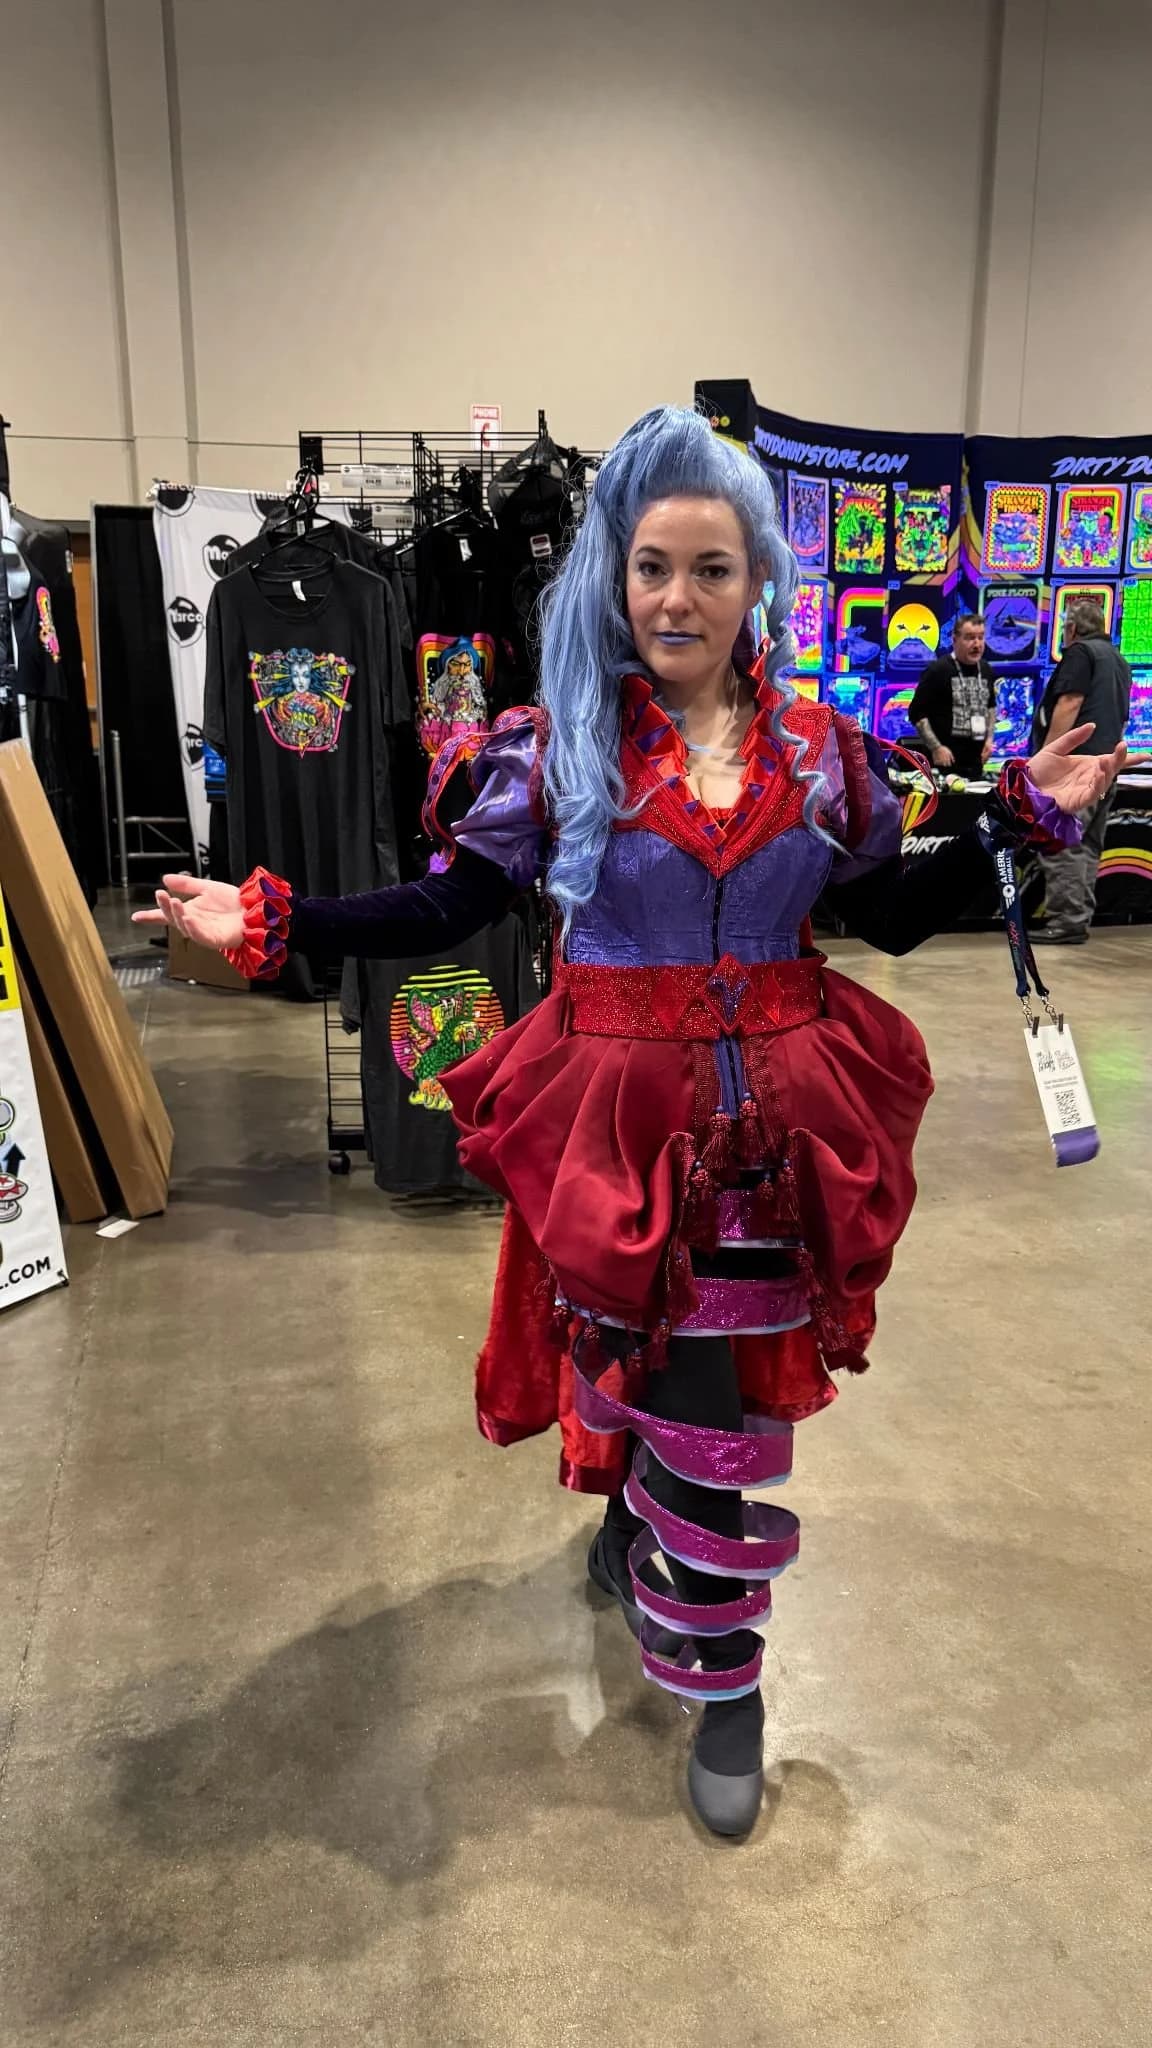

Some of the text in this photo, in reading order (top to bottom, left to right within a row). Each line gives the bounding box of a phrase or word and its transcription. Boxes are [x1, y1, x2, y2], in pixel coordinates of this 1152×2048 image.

[1050, 456, 1126, 478] DIRTY
[901, 835, 955, 858] DIRT
[0, 1256, 50, 1290] .COM
